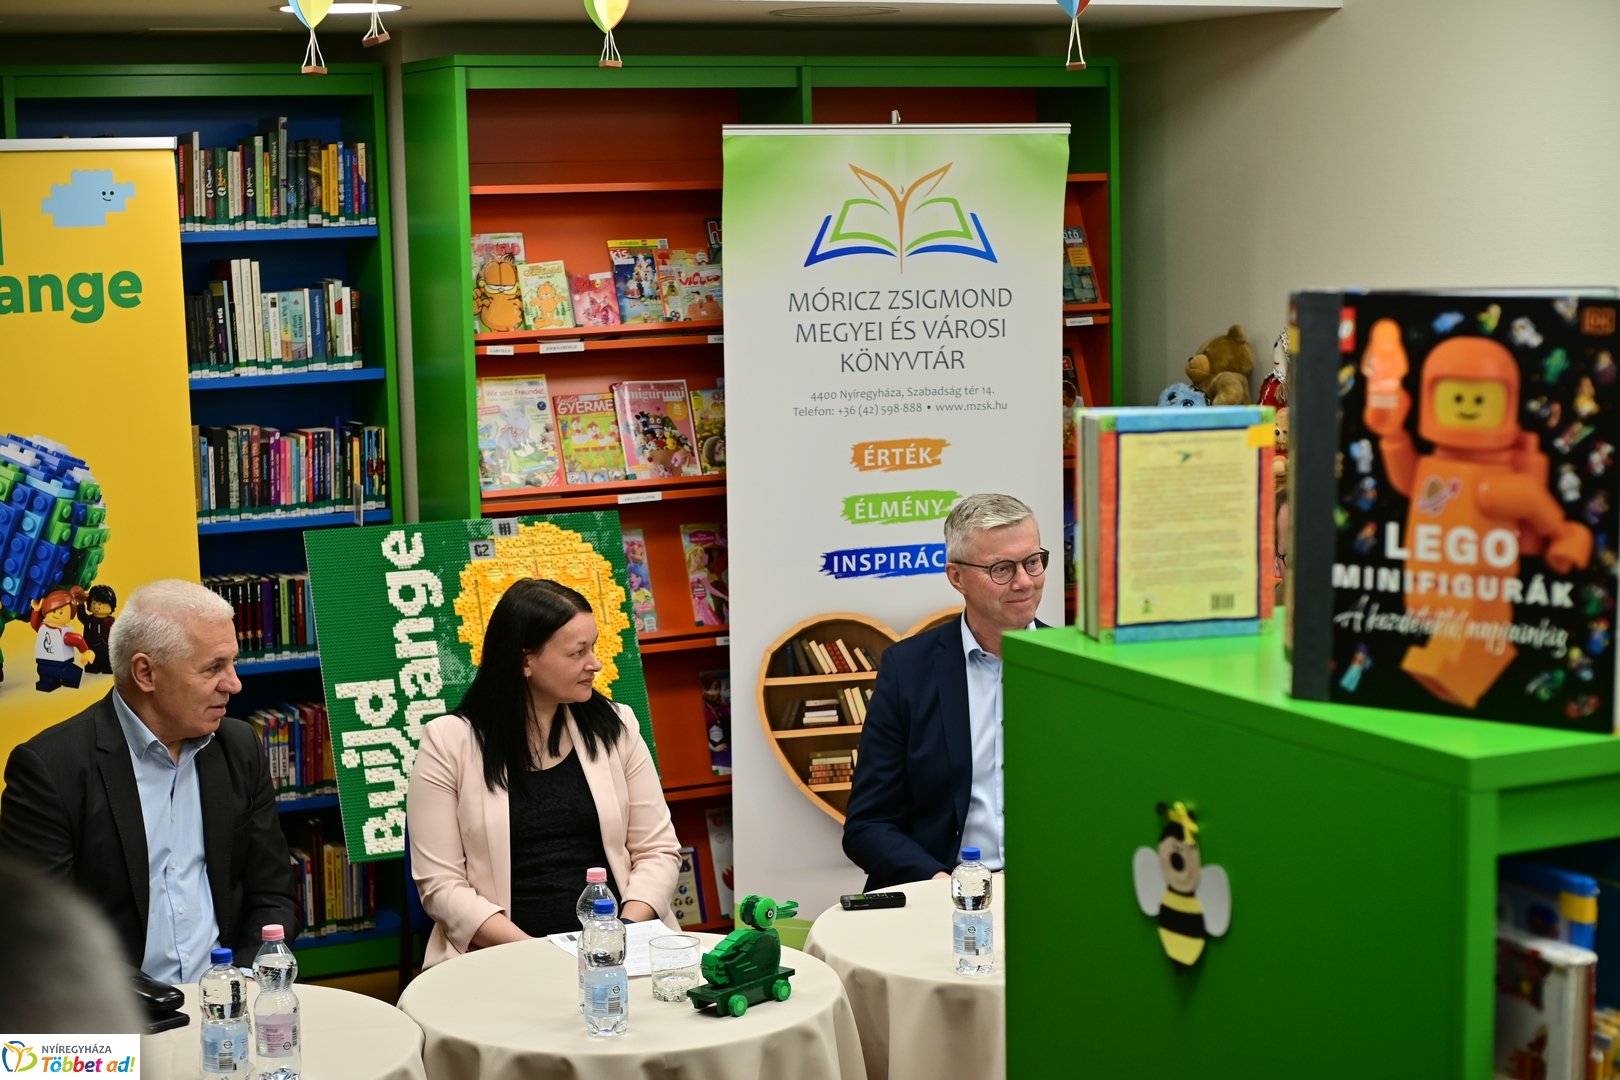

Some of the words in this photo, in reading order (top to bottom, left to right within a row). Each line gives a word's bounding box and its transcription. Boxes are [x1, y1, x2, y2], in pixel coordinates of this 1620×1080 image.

[788, 286, 881, 312] MÓRICZ
[887, 287, 1013, 310] ZSIGMOND
[795, 321, 882, 343] MEGYEI
[891, 315, 916, 341] ÉS
[922, 314, 1006, 339] VÁROSI
[841, 345, 965, 373] KÖNYVTÁR
[810, 390, 837, 401] 4400
[840, 387, 904, 402] Nyíregyháza,
[906, 385, 961, 399] Szabadság
[964, 384, 979, 396] tér
[982, 385, 995, 397] 14.
[793, 406, 835, 417] Telefon:
[838, 405, 856, 417] +36
[858, 403, 879, 417] (42)
[880, 402, 923, 416] 598-888
[935, 400, 1008, 413] www.mzsk.hu
[863, 442, 933, 467] ÉRTÉK
[854, 495, 944, 520] ÉLMÉNY
[1384, 521, 1519, 569] LEGO
[1331, 563, 1575, 608] MINIFIGURÁK
